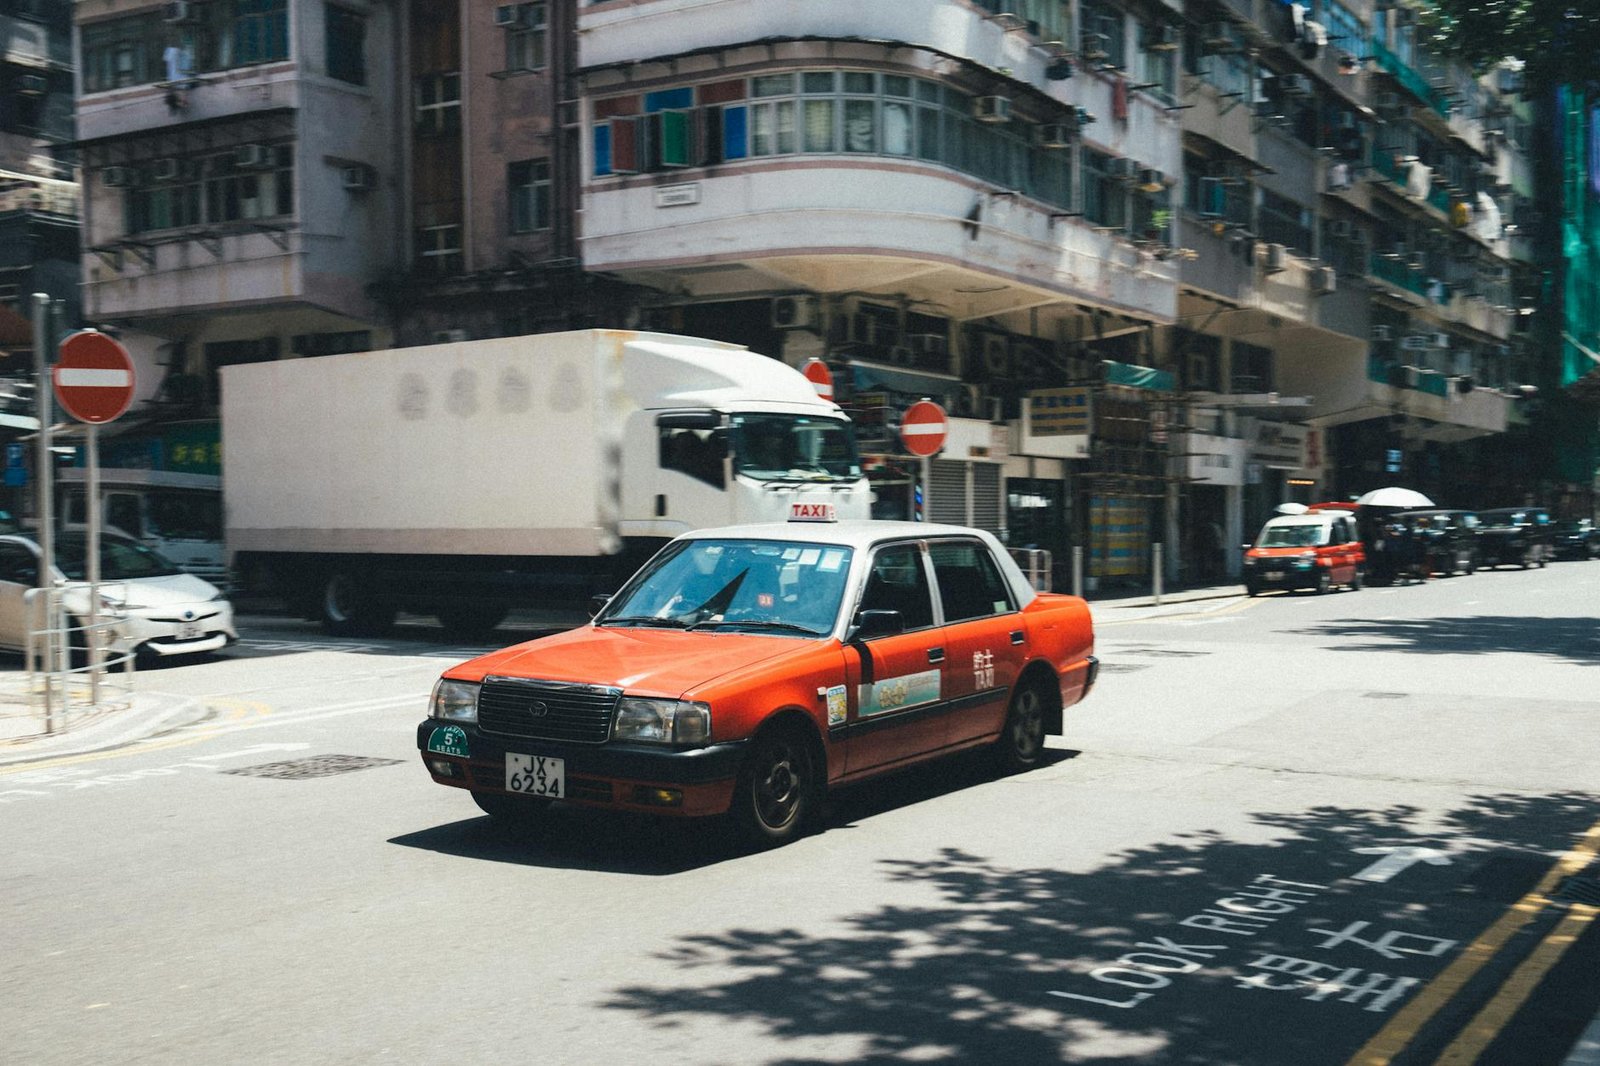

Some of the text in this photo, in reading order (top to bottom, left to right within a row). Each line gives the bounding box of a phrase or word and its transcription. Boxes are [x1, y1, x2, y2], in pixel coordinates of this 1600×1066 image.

[792, 504, 827, 517] TAXI
[973, 649, 995, 669] 的士
[444, 733, 453, 746] 5
[436, 745, 461, 755] SEATS
[523, 756, 547, 776] JX
[510, 772, 560, 797] 6234
[1046, 873, 1330, 1008] LOOK RIGHT
